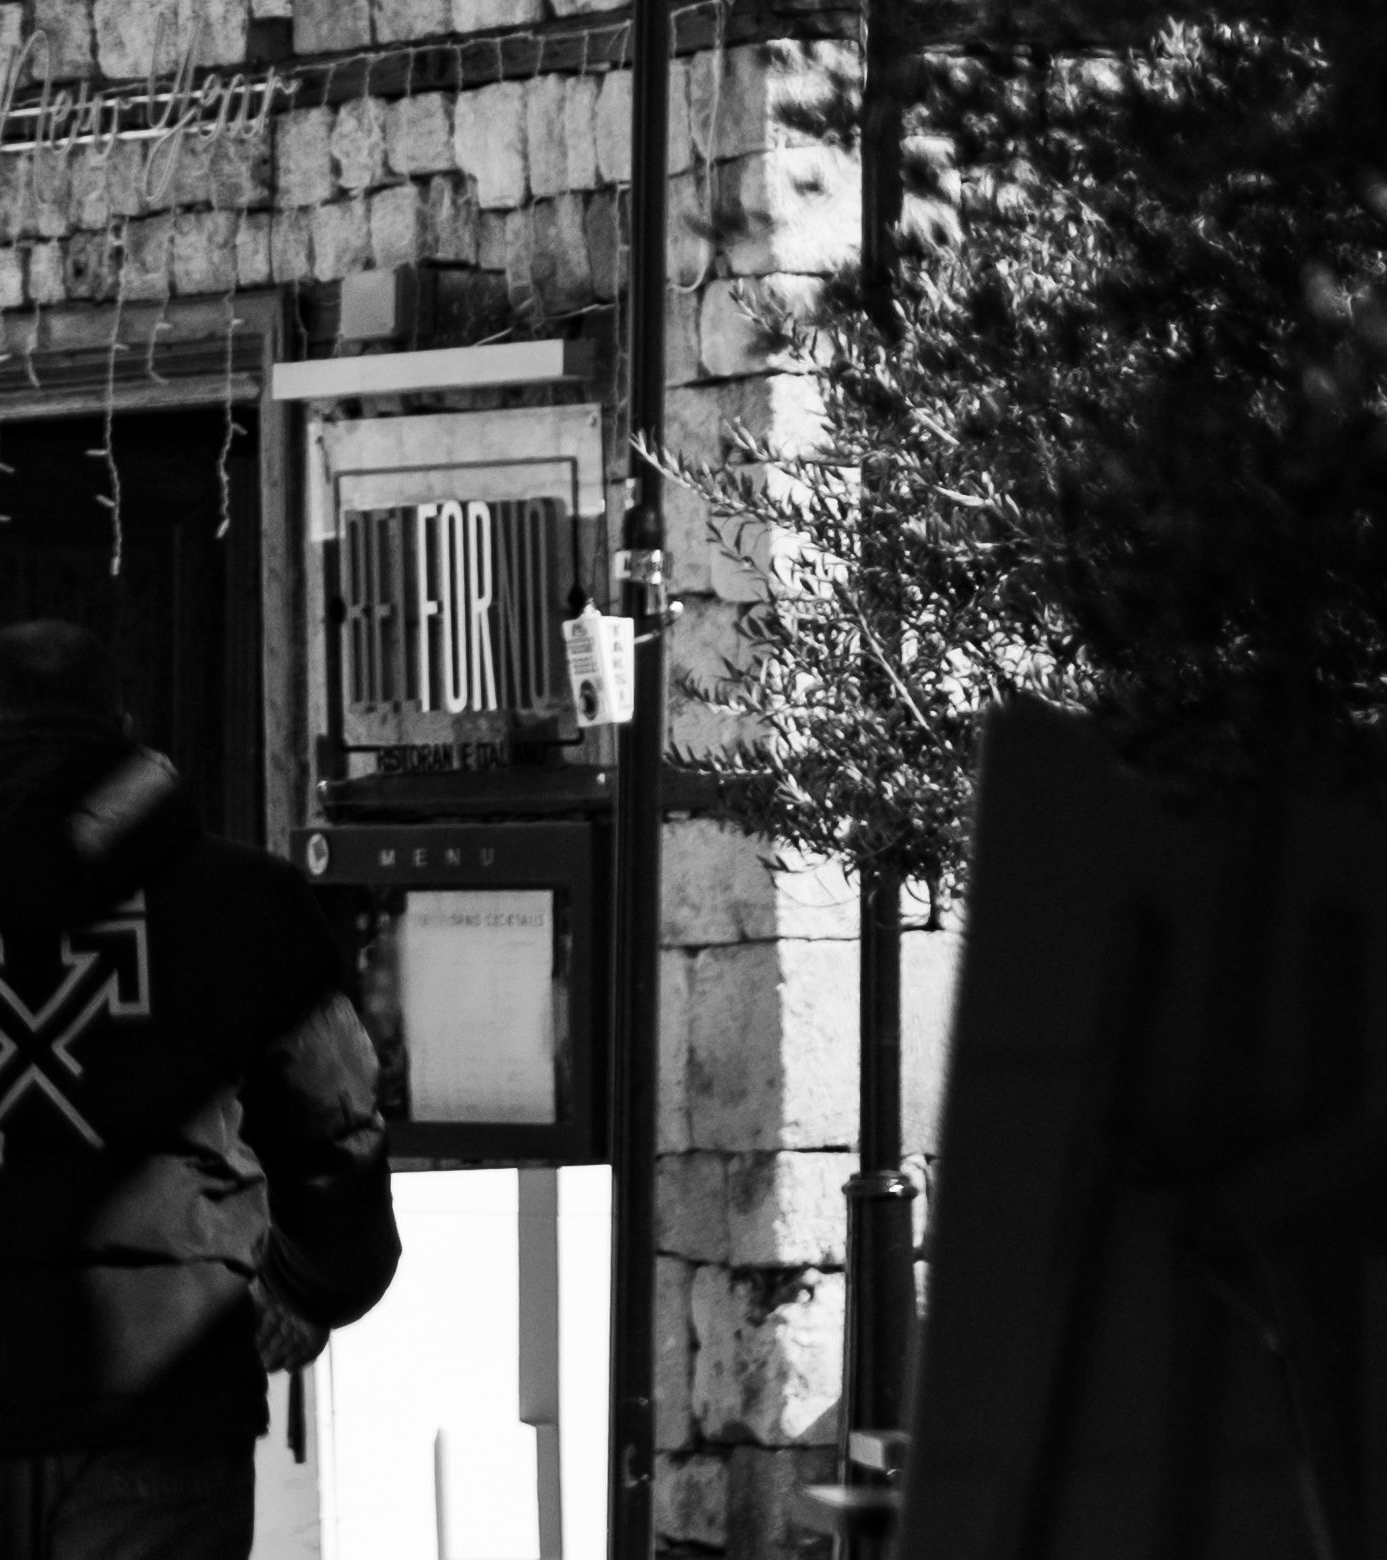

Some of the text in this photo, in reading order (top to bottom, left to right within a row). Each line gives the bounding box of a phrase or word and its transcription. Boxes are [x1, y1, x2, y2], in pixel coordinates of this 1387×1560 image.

[377, 741, 545, 774] RISTORANE ITAL
[379, 847, 496, 867] MENU
